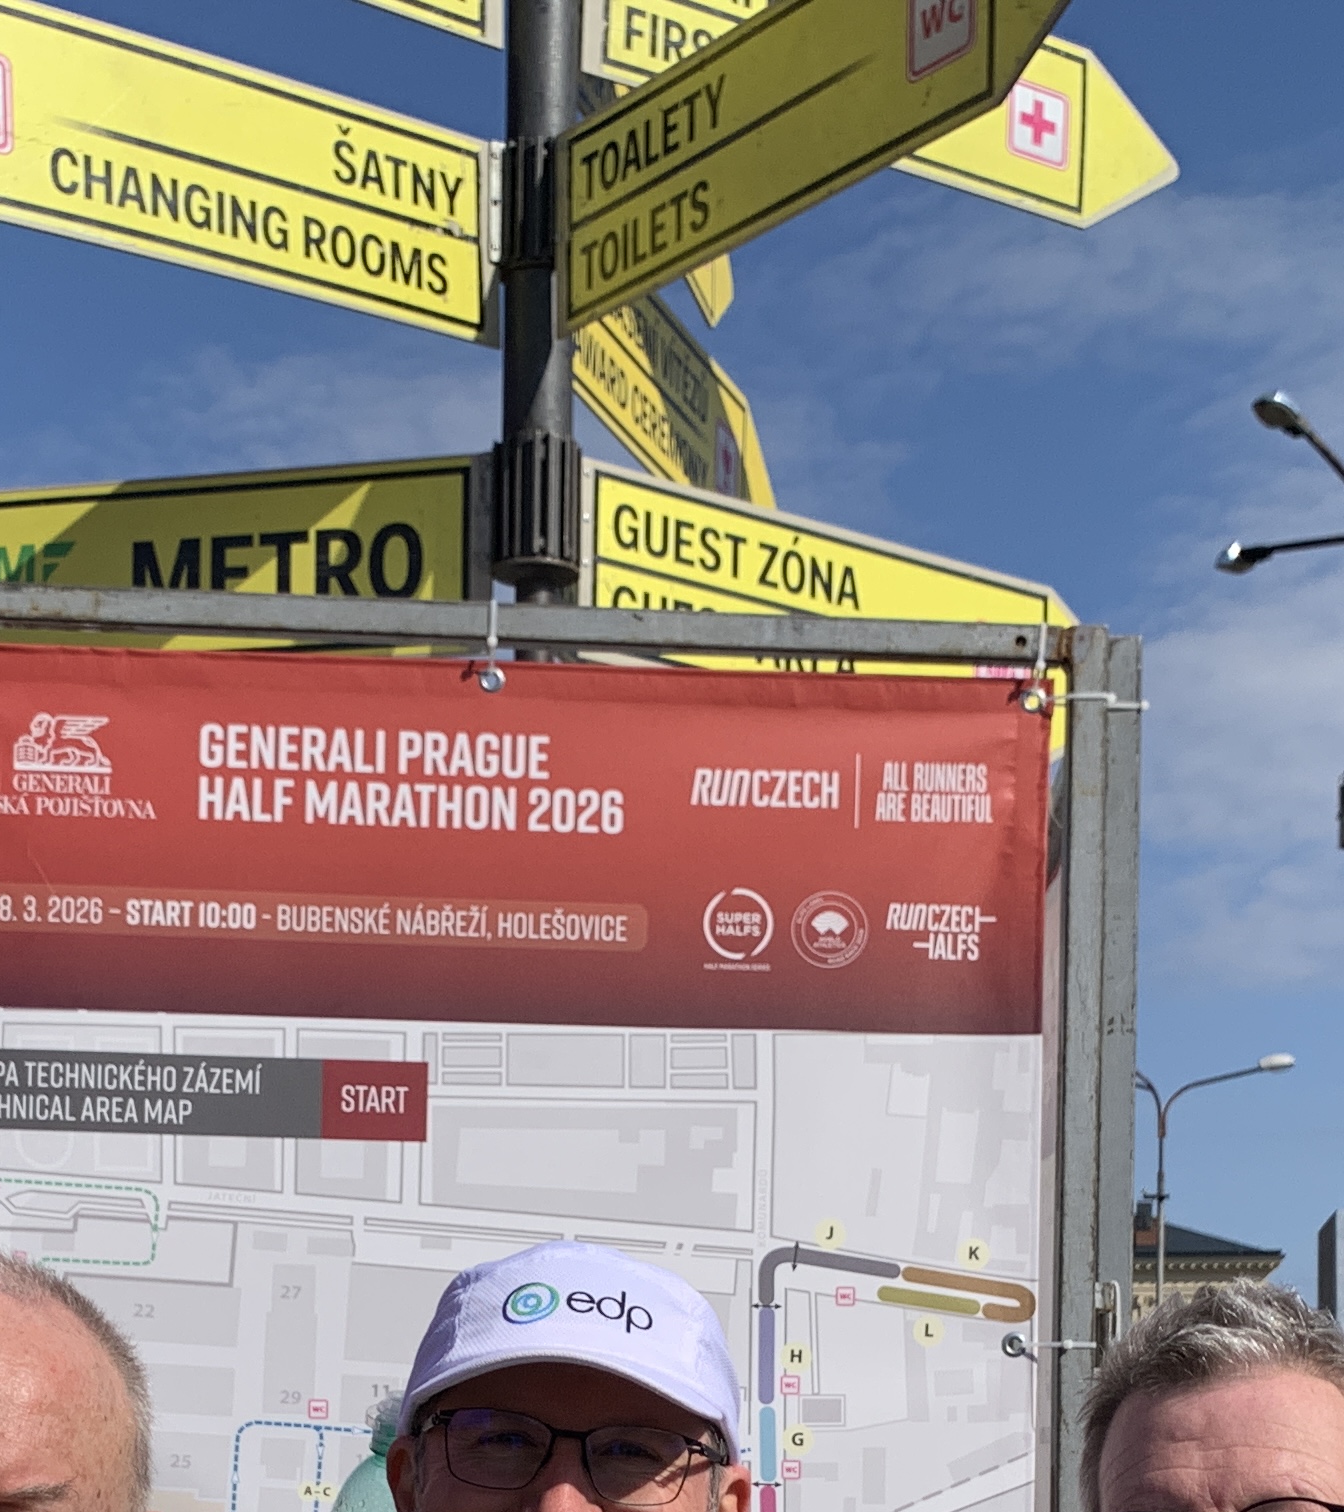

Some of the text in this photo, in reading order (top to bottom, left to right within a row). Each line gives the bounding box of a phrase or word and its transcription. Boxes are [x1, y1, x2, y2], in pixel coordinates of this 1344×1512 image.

[921, 1, 963, 40] WC
[579, 73, 726, 200] TOALETY
[331, 123, 464, 217] ŠATNY
[49, 147, 450, 296] CHANGING ROOMS
[579, 179, 711, 291] TOILETS
[131, 522, 424, 598] METRO
[612, 503, 861, 612] GUEST ZÓNA
[198, 722, 551, 780] GENERALI PRAGUE
[12, 772, 112, 796] GENERALI
[689, 767, 840, 810] RUNCZECH
[882, 760, 988, 794] ALL RUNNERS
[34, 794, 156, 820] POJIŠŤOVNA
[197, 775, 625, 835] HALF MARATHON 2026
[874, 790, 994, 824] ARE BEAUTIFUL
[23, 895, 42, 923] 3.
[47, 895, 103, 925] 2026
[125, 899, 194, 929] START
[199, 901, 256, 930] 10:00
[276, 903, 390, 937] BUBENSKÉ
[395, 904, 494, 941] NÁBŘEŽÍ,
[497, 906, 628, 943] HOLEŠOVICE
[715, 911, 762, 925] SUPER
[715, 924, 762, 937] HALFS
[24, 1059, 177, 1092] TECHNICKÉHO
[181, 1062, 263, 1095] ZÁZEMÍ
[81, 1096, 139, 1124] AREA
[143, 1098, 193, 1125] MAP
[340, 1084, 410, 1115] START
[968, 1246, 980, 1261] K
[566, 1290, 654, 1334] edp
[924, 1323, 934, 1339] L
[790, 1349, 803, 1364] H
[791, 1431, 805, 1447] G
